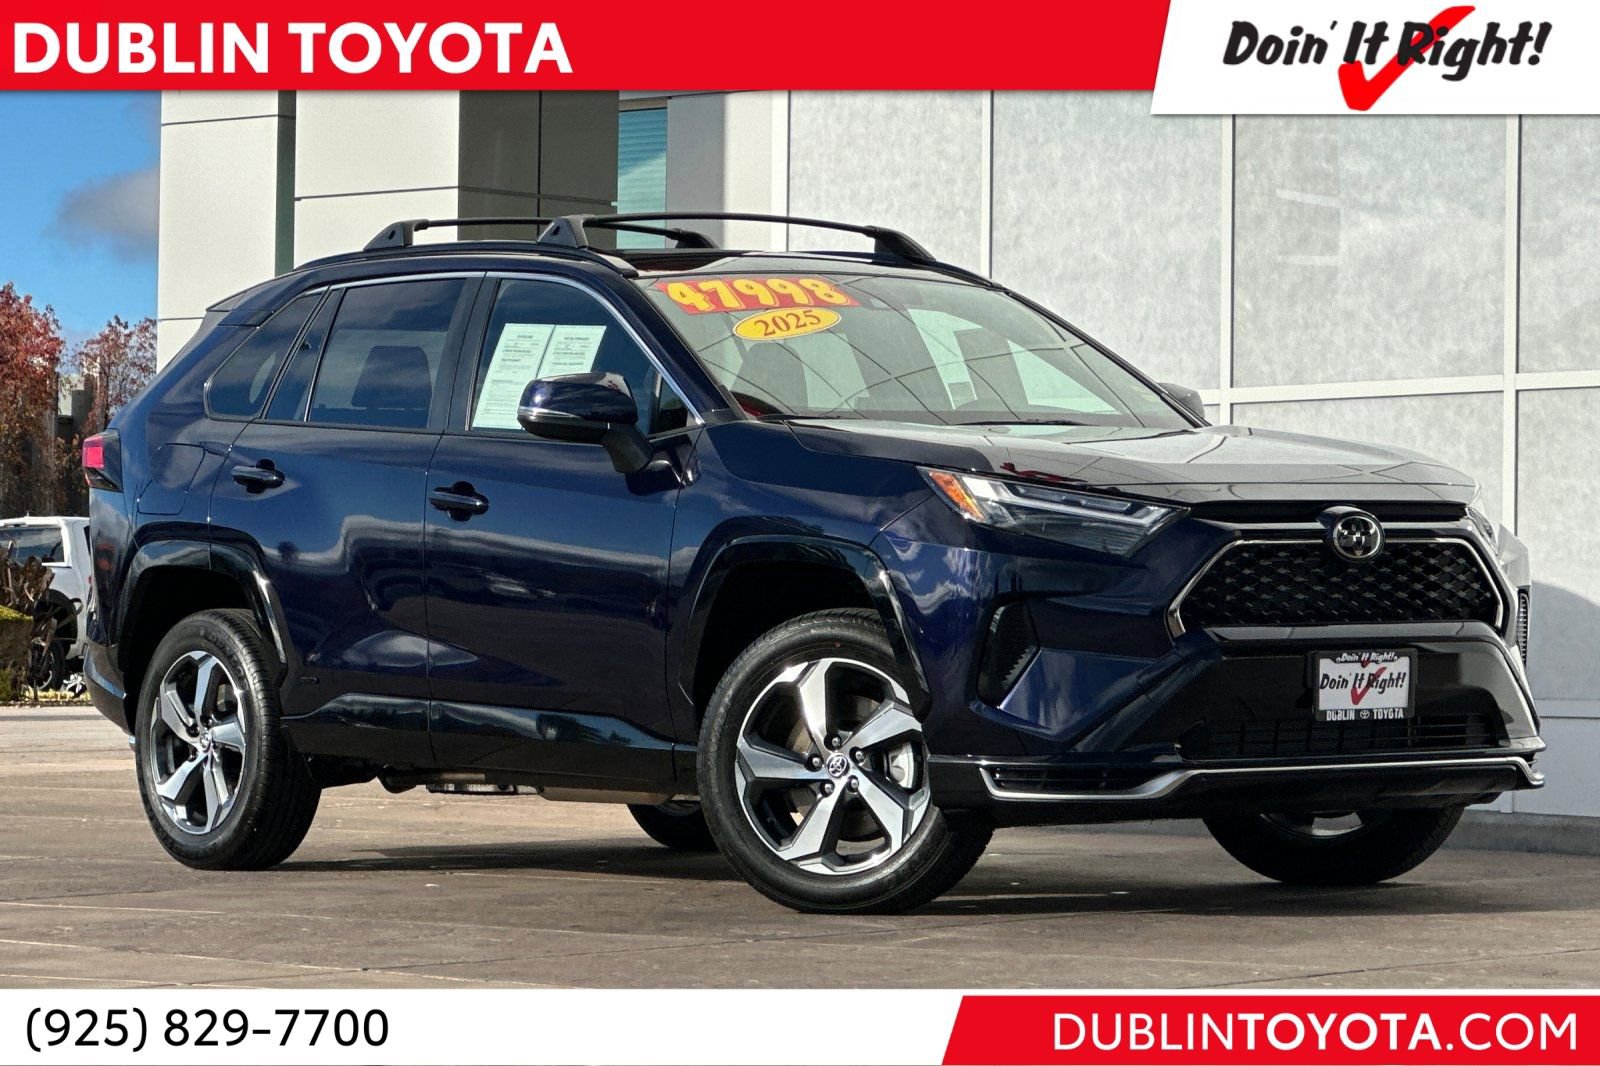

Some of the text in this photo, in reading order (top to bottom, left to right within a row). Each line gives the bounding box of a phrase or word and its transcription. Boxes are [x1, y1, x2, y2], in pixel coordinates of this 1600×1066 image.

[667, 278, 849, 311] 47998
[754, 309, 821, 337] 2025
[1320, 672, 1407, 694] Doin' It Right!
[1326, 708, 1404, 721] DUBLIN TOYOTA
